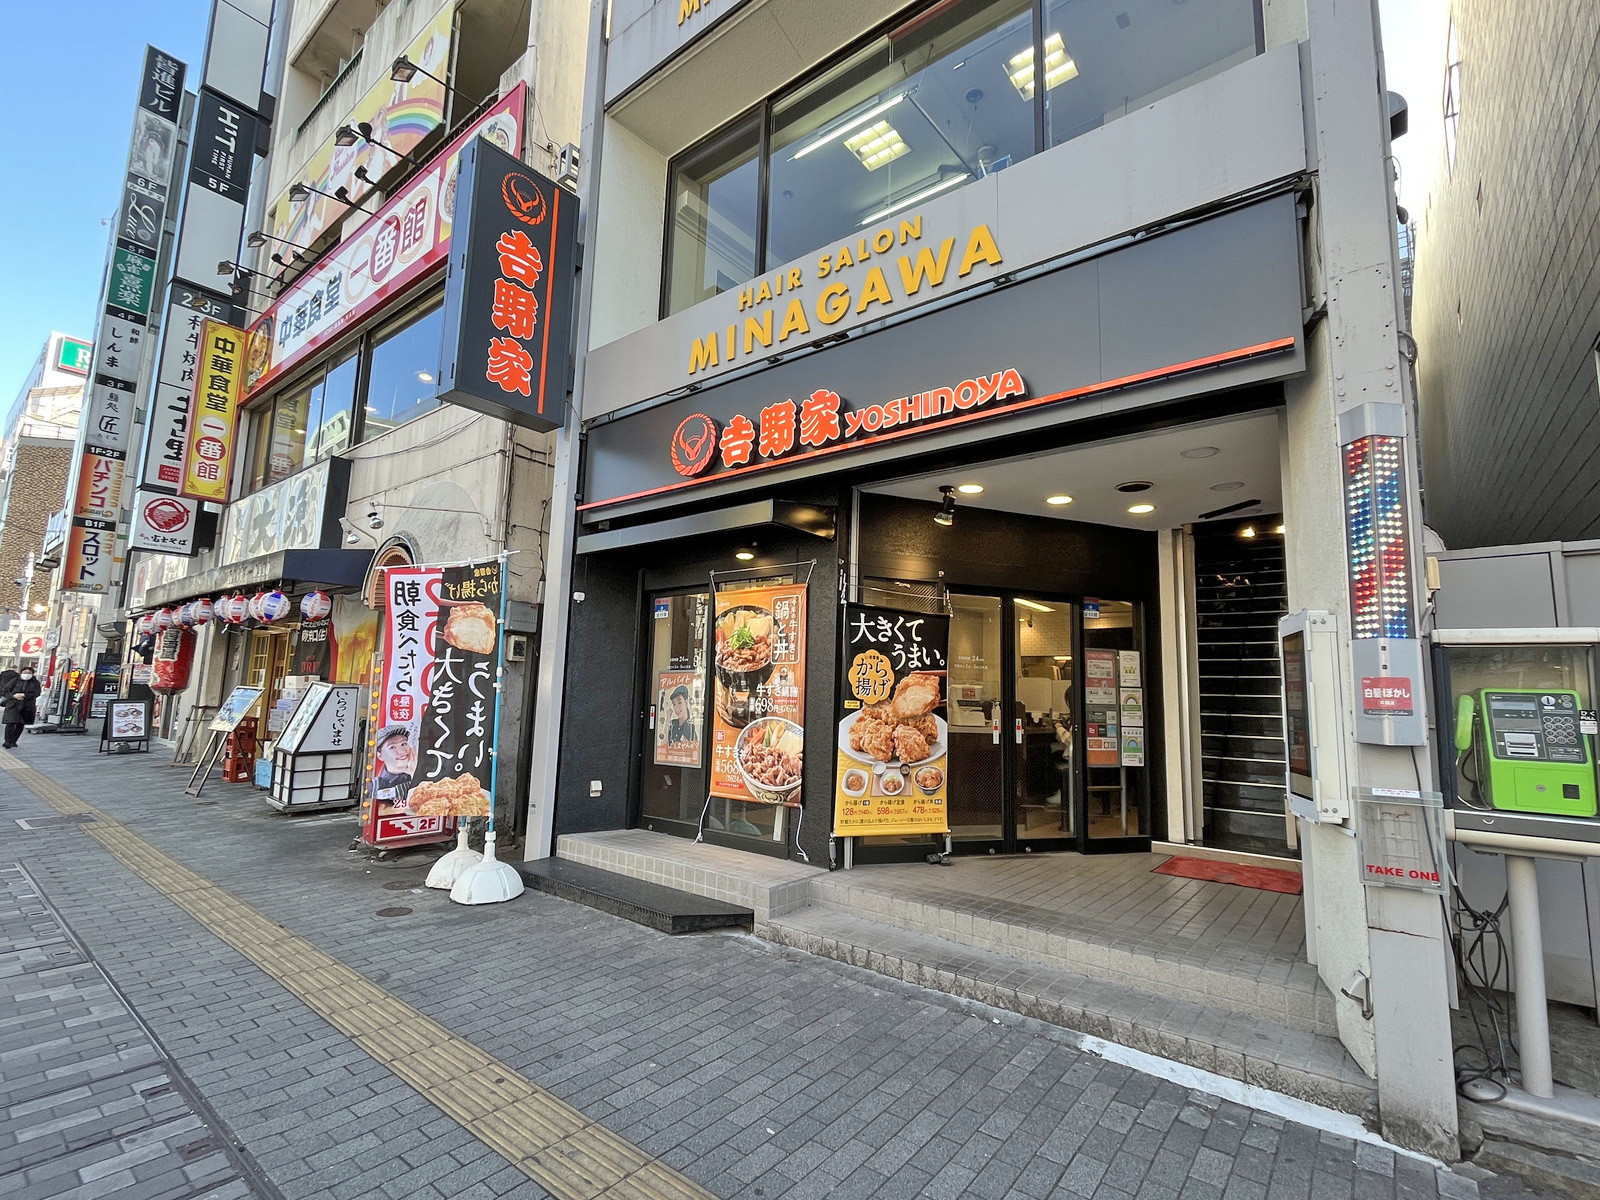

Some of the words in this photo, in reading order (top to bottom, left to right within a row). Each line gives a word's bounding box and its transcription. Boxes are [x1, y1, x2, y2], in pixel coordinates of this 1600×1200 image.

[738, 266, 803, 312] HAIR
[817, 215, 922, 278] SALON
[486, 229, 543, 397] 吉野家
[687, 224, 1003, 375] MINAGAWA
[719, 388, 841, 468] 吉野家
[89, 459, 113, 508] パチンコ
[80, 531, 101, 580] スロット
[773, 600, 789, 660] 鍋と丼
[850, 612, 924, 644] 大きくて
[857, 658, 888, 680] から
[891, 643, 945, 670] うまい。
[855, 677, 891, 697] 揚げ
[1364, 688, 1410, 698] 白髪ぼかし
[331, 690, 349, 746] いらっしゃいませ
[419, 818, 436, 830] 2F
[1366, 864, 1404, 877] TAKE
